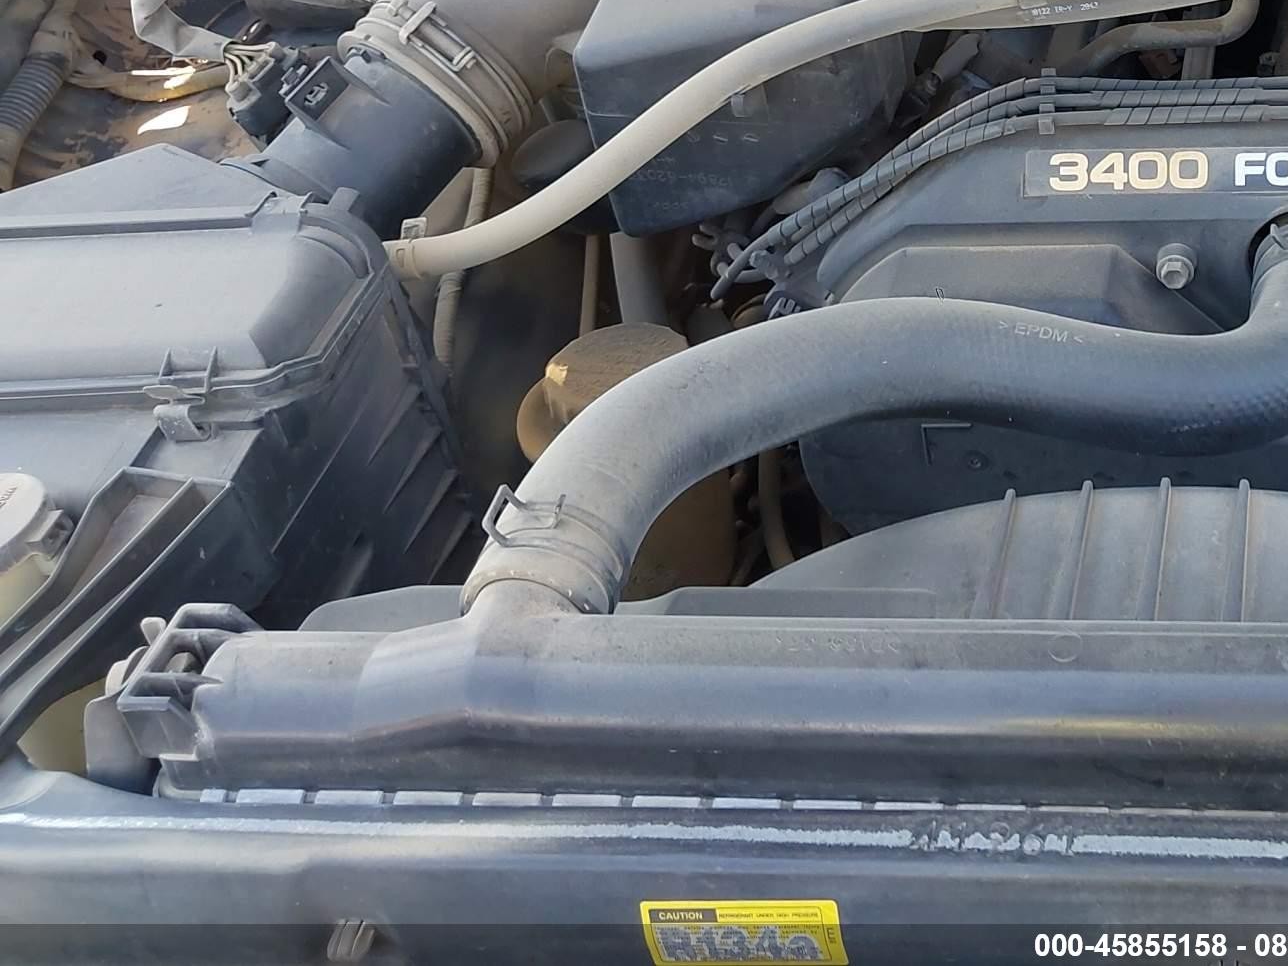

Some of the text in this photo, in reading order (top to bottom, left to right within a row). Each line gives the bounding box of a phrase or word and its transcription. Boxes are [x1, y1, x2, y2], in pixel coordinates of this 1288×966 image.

[1049, 152, 1210, 191] 3400
[1014, 322, 1068, 342] EPDM
[659, 911, 703, 920] CAUTION
